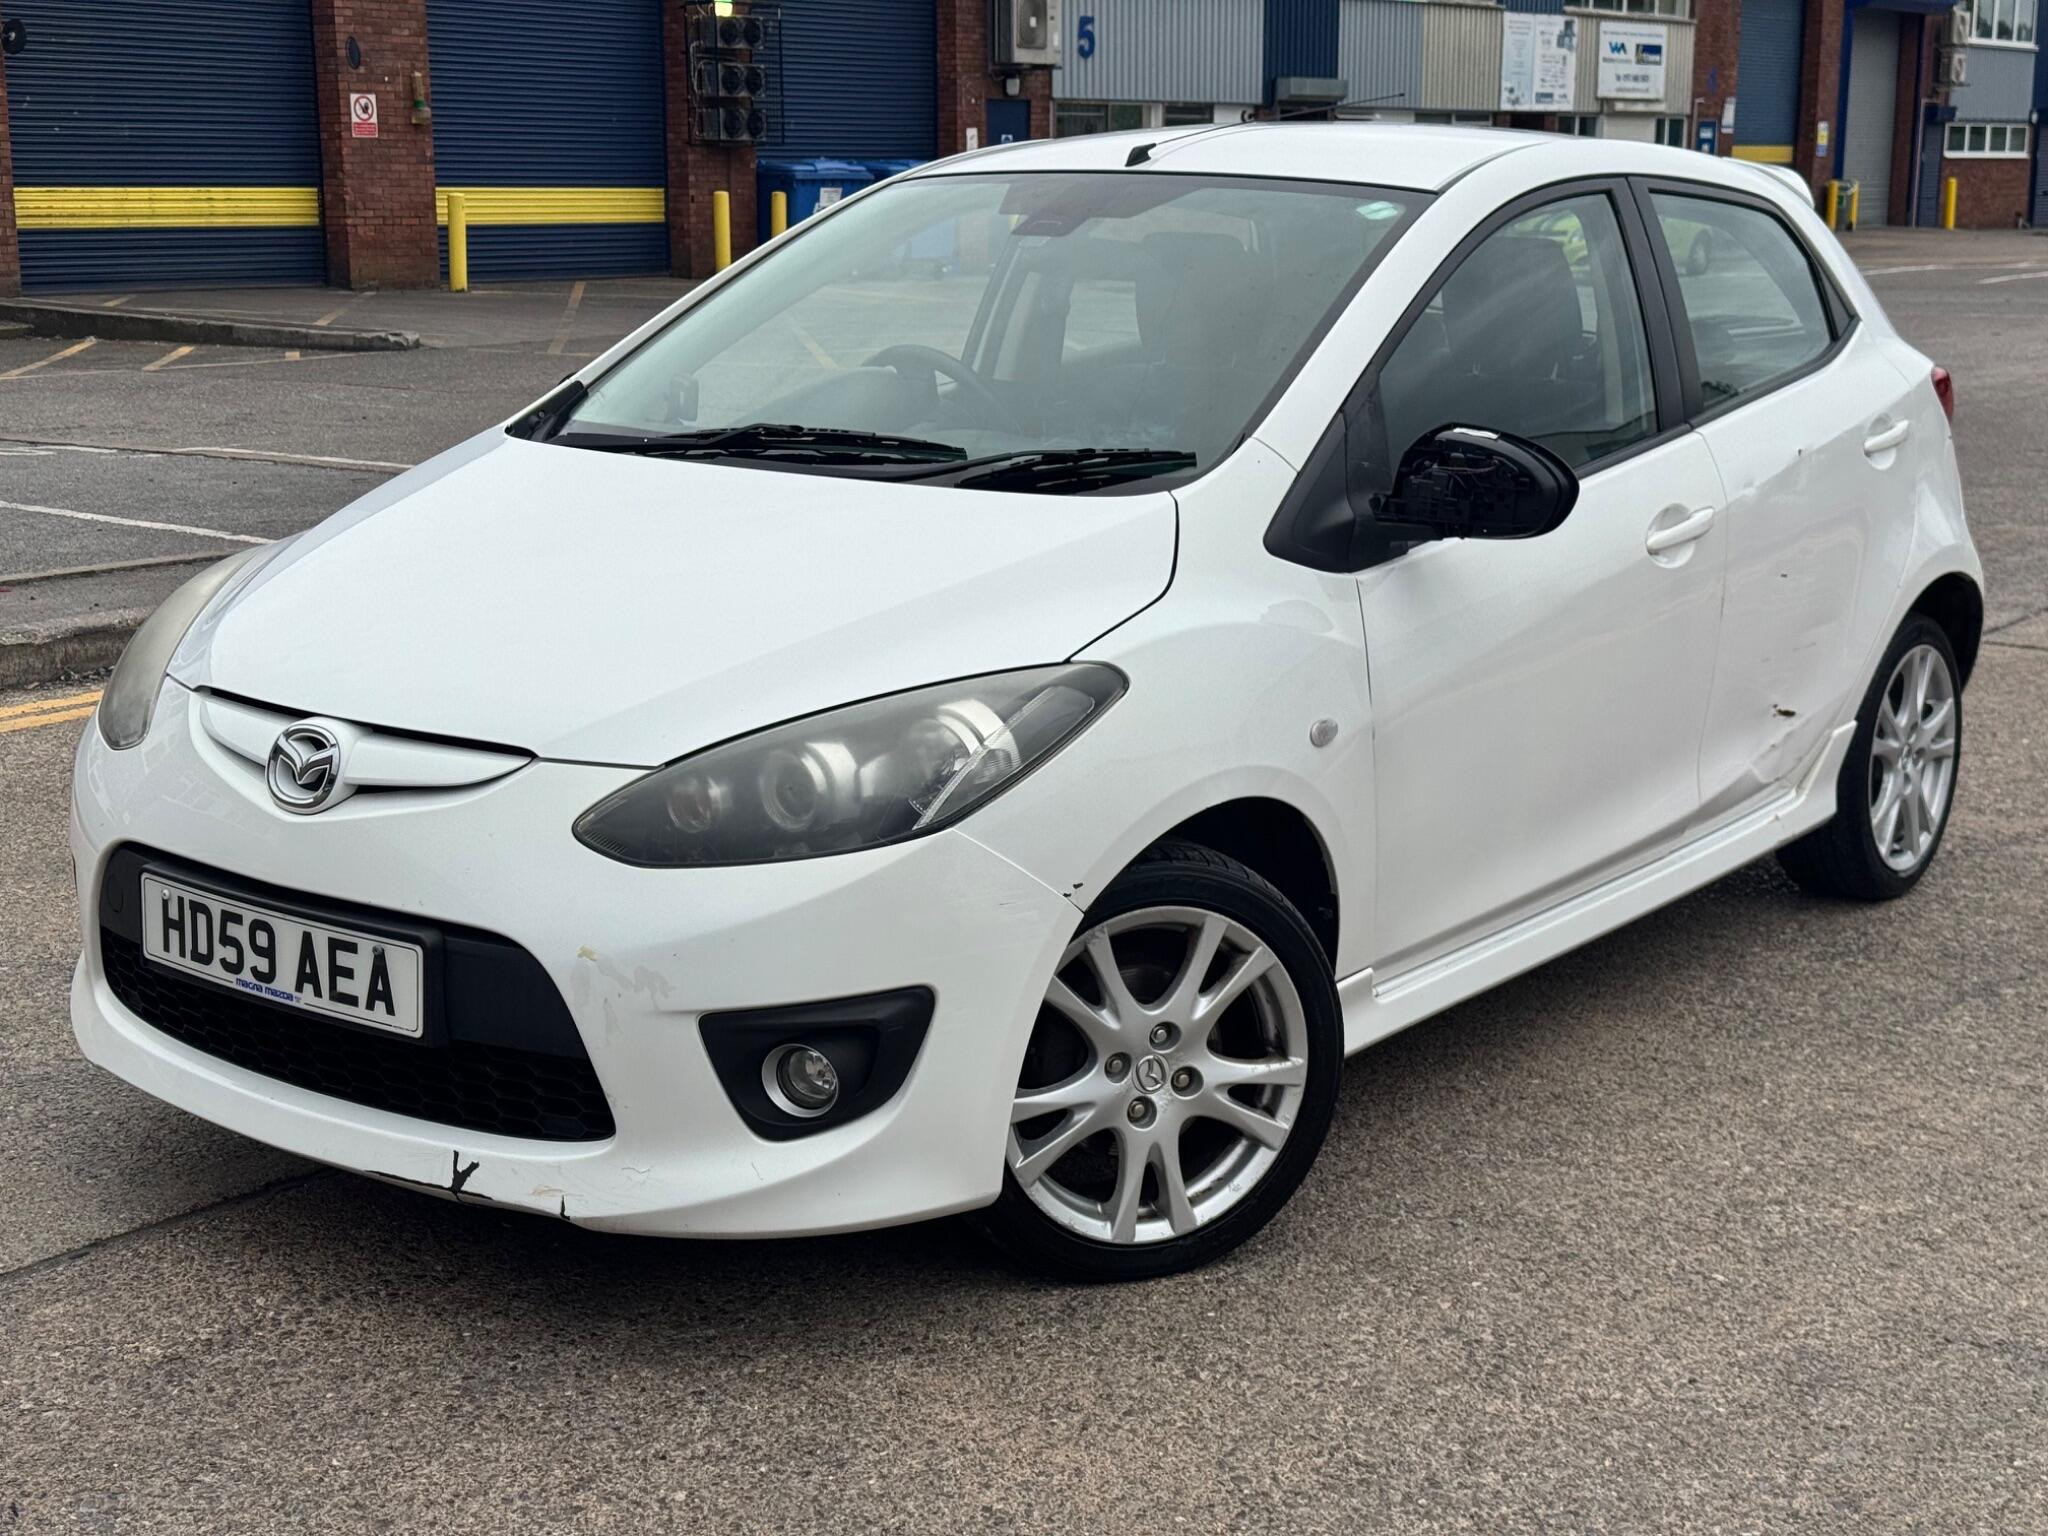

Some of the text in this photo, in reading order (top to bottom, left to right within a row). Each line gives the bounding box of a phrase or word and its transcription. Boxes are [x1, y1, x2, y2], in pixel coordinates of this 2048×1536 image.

[1078, 15, 1096, 60] 5
[161, 894, 396, 1017] HD59 AEA
